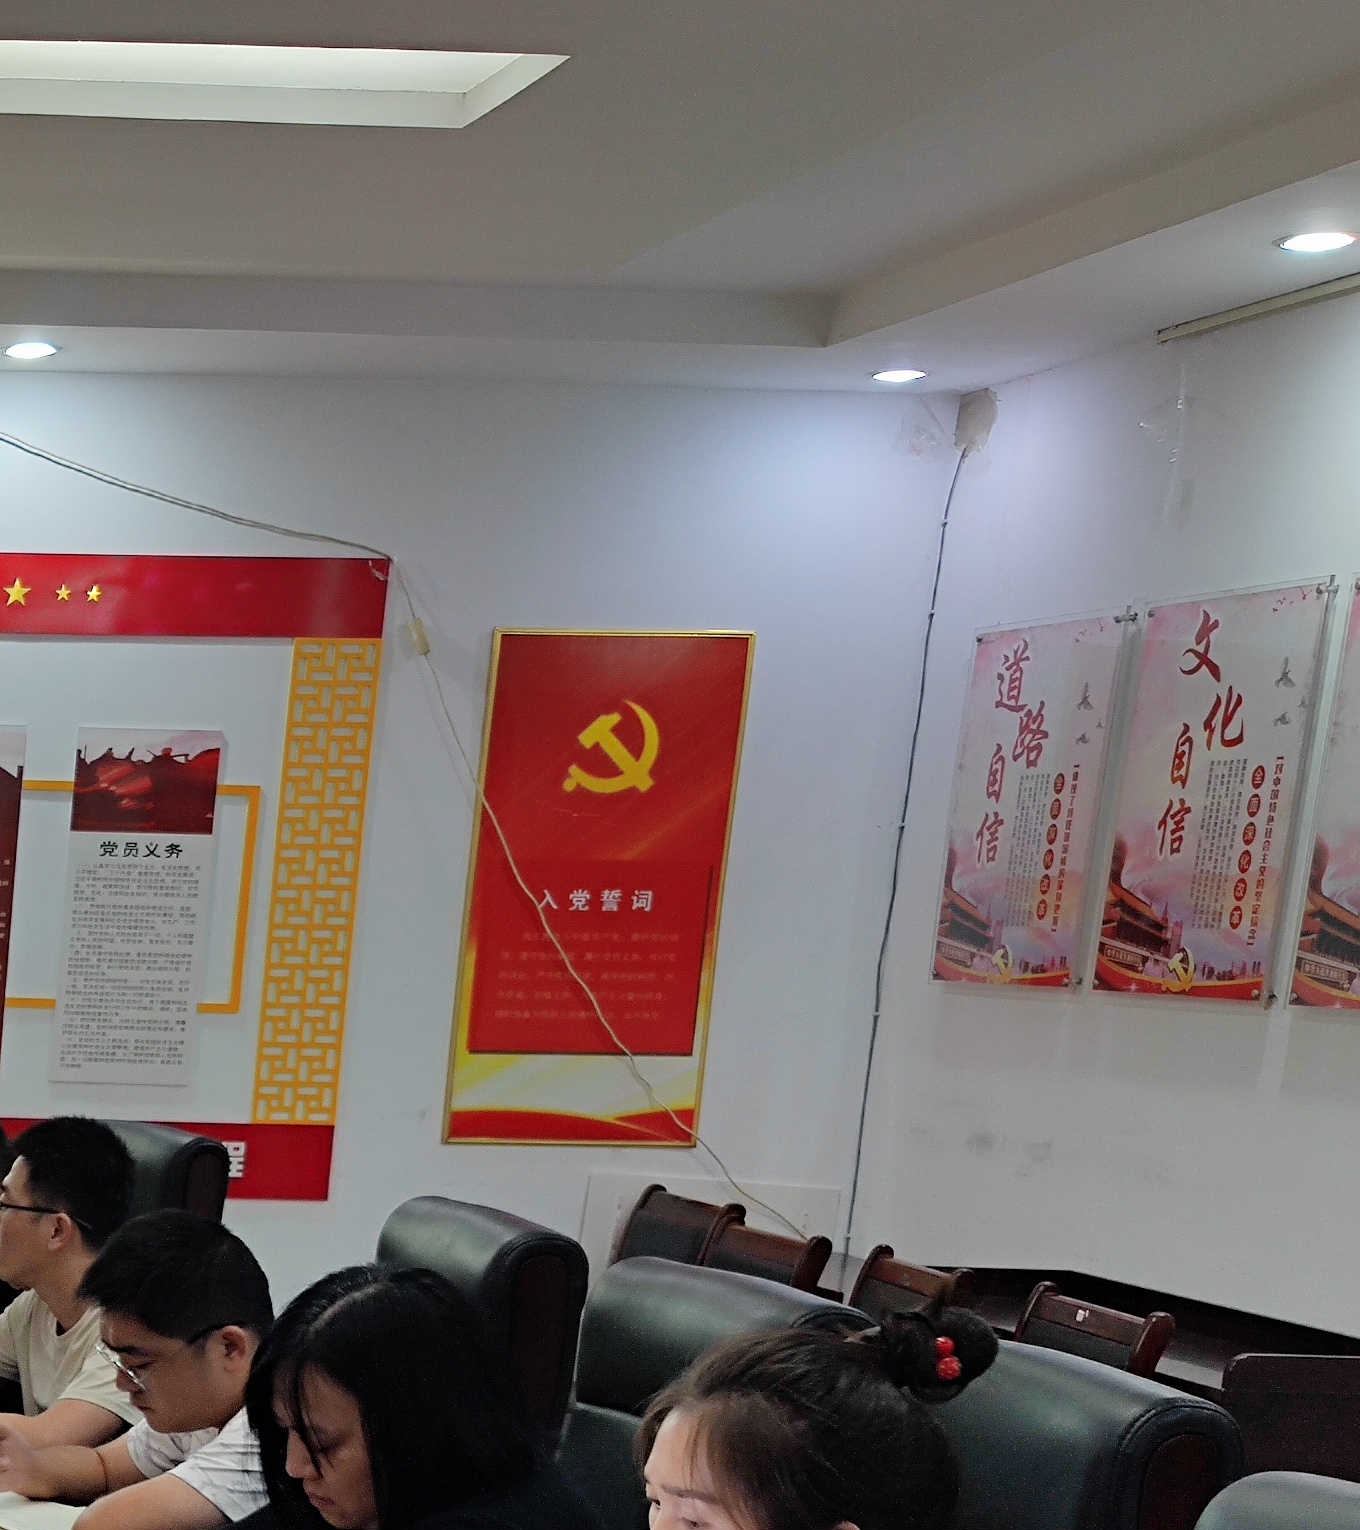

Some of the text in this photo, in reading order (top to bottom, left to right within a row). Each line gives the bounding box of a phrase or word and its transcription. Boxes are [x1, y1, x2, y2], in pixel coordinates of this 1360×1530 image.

[996, 639, 1049, 768] 道路
[1179, 609, 1244, 751] 文化
[99, 841, 183, 859] 党员义务
[976, 744, 1006, 865] 自信
[1158, 722, 1194, 858] 自信
[538, 889, 653, 912] 入党誓词
